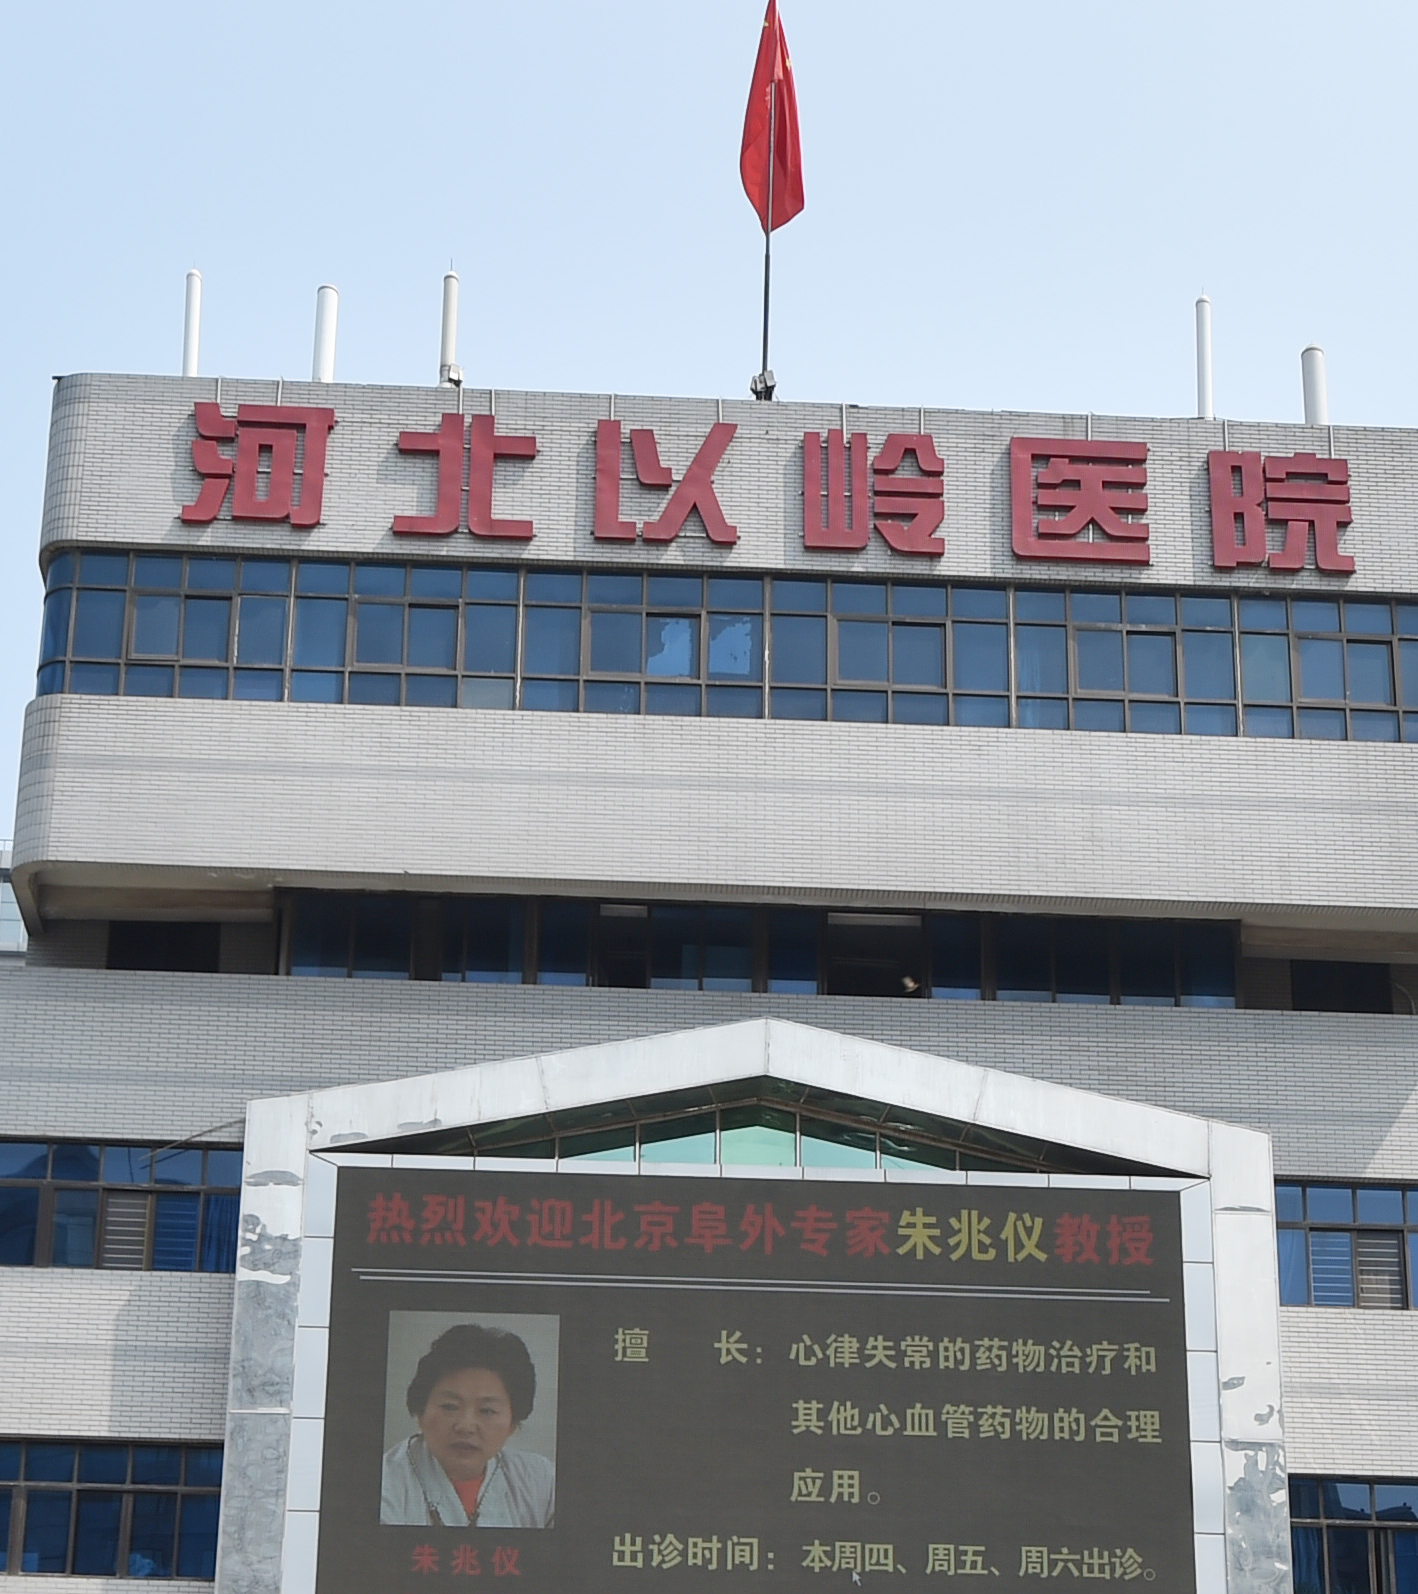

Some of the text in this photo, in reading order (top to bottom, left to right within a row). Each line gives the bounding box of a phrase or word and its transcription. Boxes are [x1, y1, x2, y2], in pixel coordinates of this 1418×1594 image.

[180, 401, 1356, 576] 河北以岭医院
[366, 1192, 1156, 1268] 热烈欢迎北京阜外专家朱兆仪教授
[789, 1332, 1158, 1376] 心律失常的药物治疗和
[790, 1399, 1162, 1446] 其他心血管药物的合理
[411, 1544, 521, 1577] 朱兆仪
